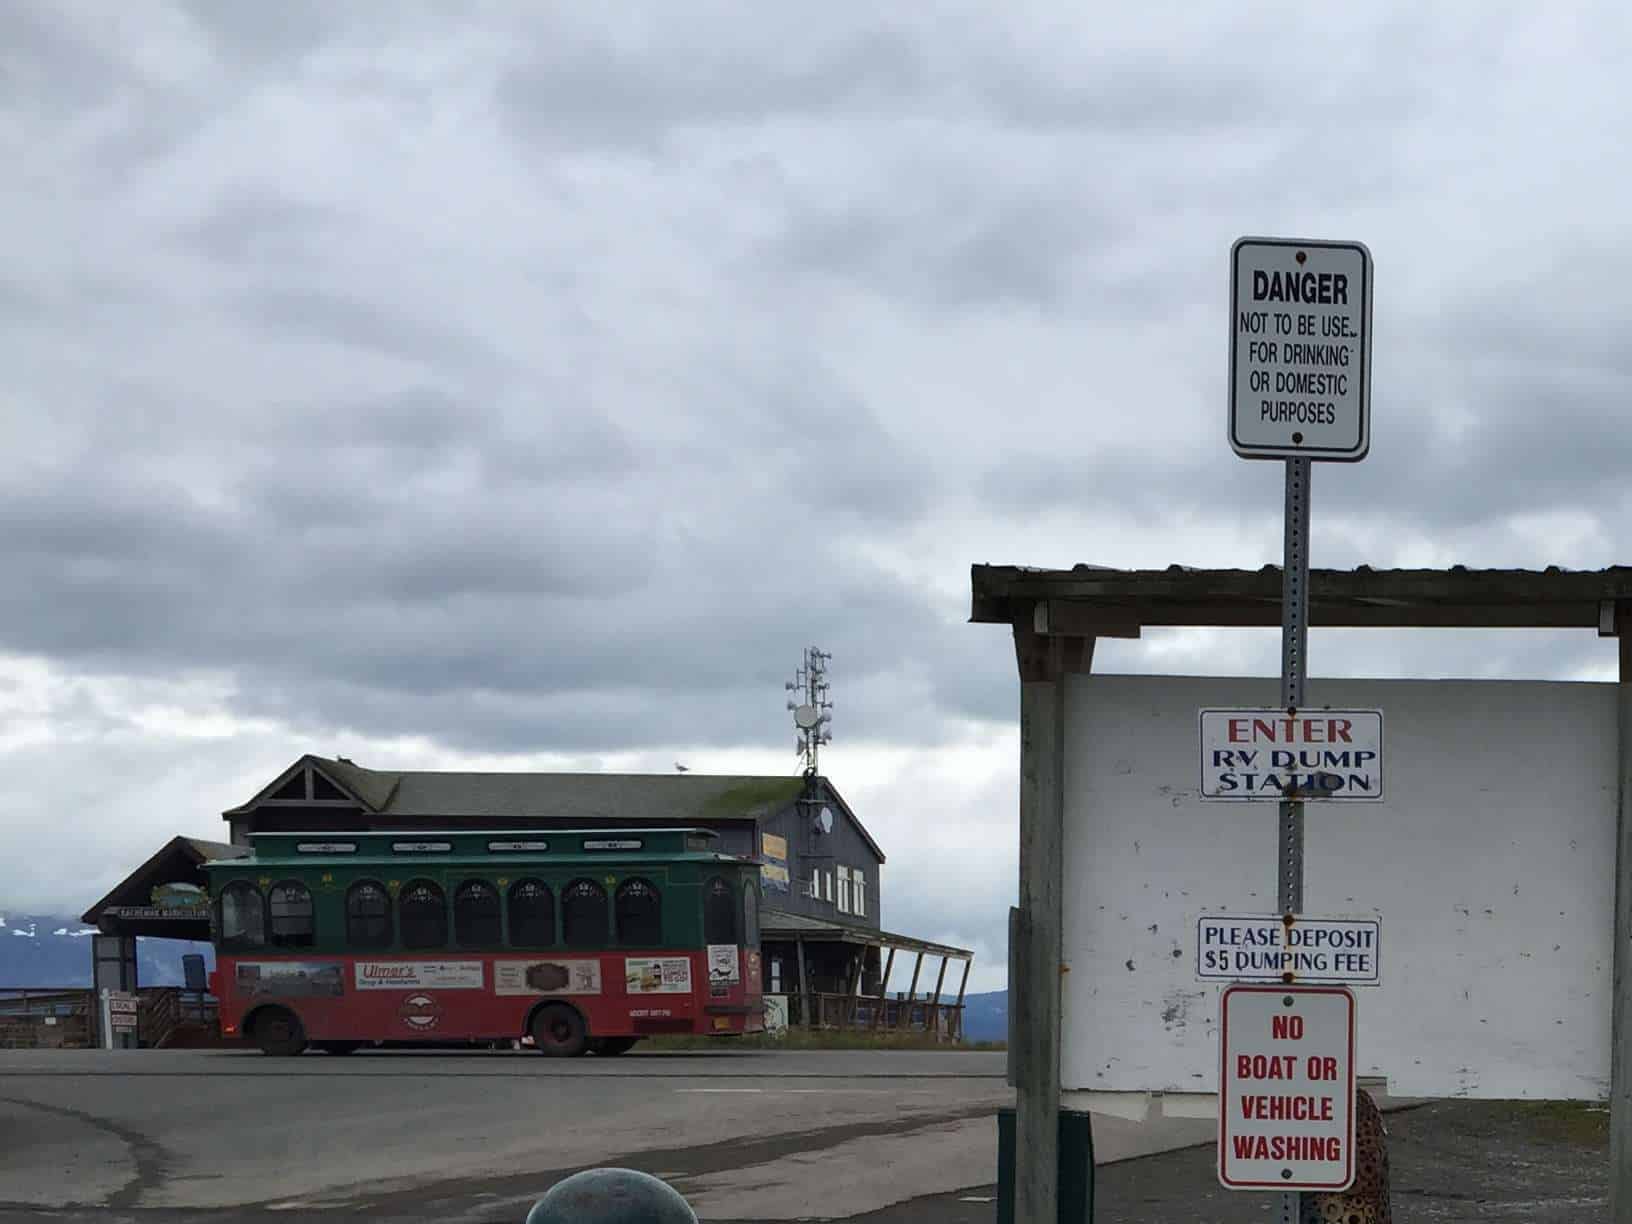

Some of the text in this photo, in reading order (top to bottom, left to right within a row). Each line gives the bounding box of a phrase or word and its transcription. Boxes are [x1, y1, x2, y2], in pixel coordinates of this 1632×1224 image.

[1253, 270, 1348, 305] DANGER
[1240, 311, 1357, 338] NOT TO BE USE
[1249, 341, 1349, 367] FOR DRINKING
[1249, 370, 1348, 396] OR DOMESTIC
[1260, 400, 1336, 425] PURPOSES
[1228, 718, 1353, 743] ENTER
[1213, 749, 1376, 769] RV DUMP
[1218, 773, 1370, 791] STATION
[1205, 926, 1374, 949] PLEASE DEPOSIT
[1205, 950, 1370, 972] $5 DUMPING FEE
[1272, 1015, 1304, 1040] NO
[1237, 1055, 1338, 1081] BOAT OR
[1241, 1095, 1334, 1121] VEHICLE
[1233, 1135, 1341, 1162] WASHING
